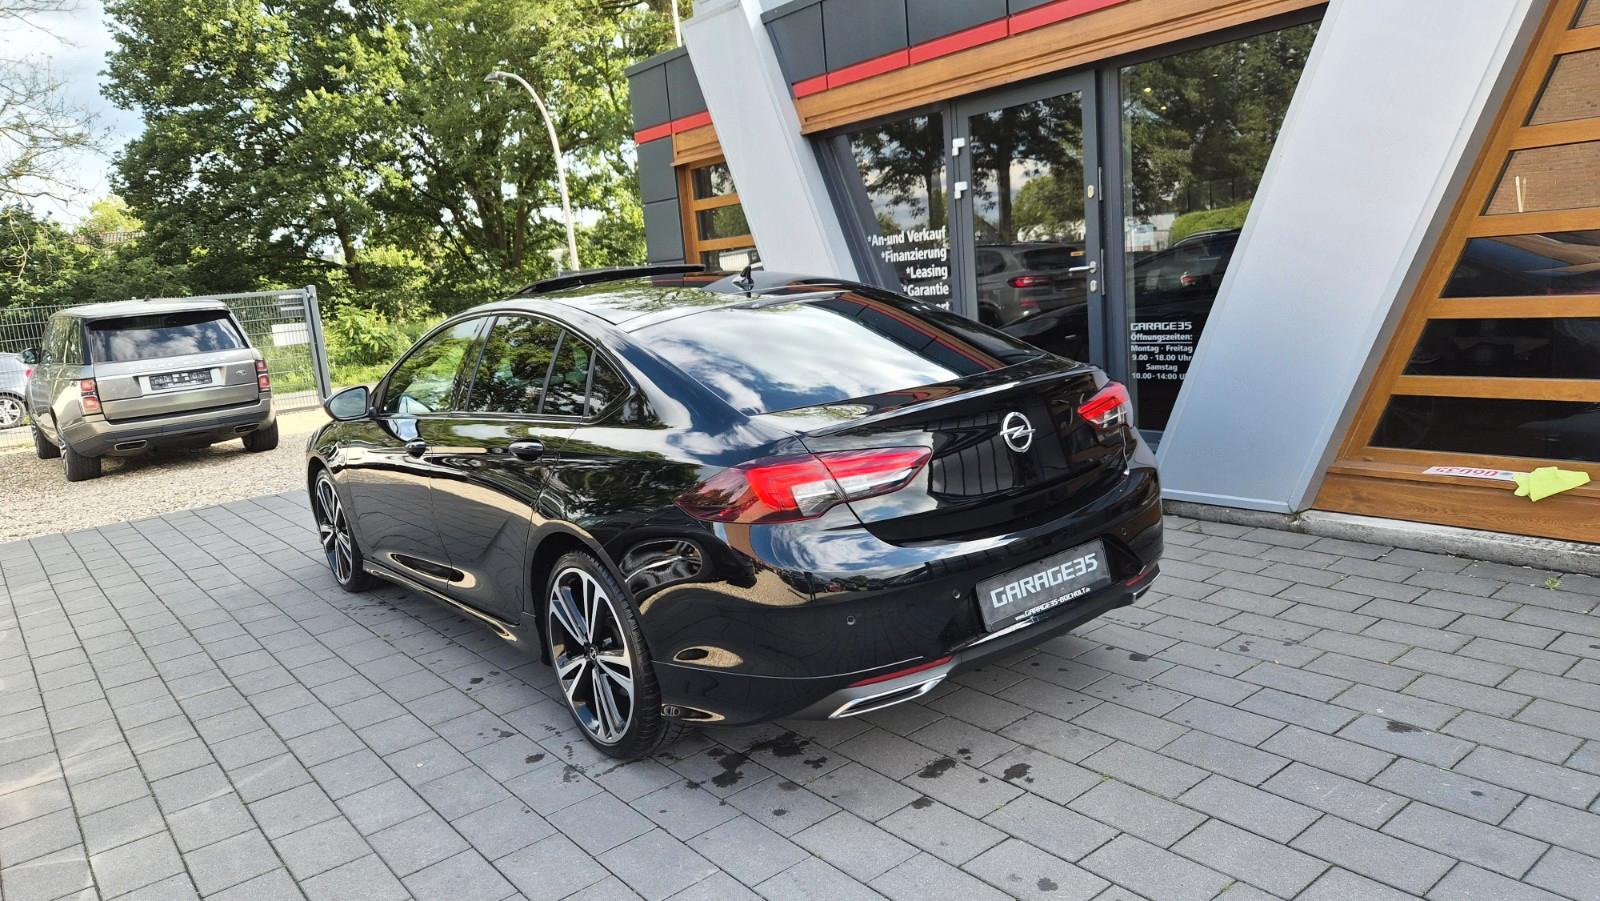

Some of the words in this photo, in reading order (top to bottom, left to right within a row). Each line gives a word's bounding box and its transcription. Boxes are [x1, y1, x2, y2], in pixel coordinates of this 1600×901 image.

[907, 225, 946, 242] Verkauf
[1130, 322, 1192, 330] GARAGE35
[1130, 332, 1193, 342] Öffnungszeiten:
[1130, 345, 1159, 353] Montag
[1165, 345, 1193, 353] Freitag
[990, 552, 1098, 609] GARAGE35
